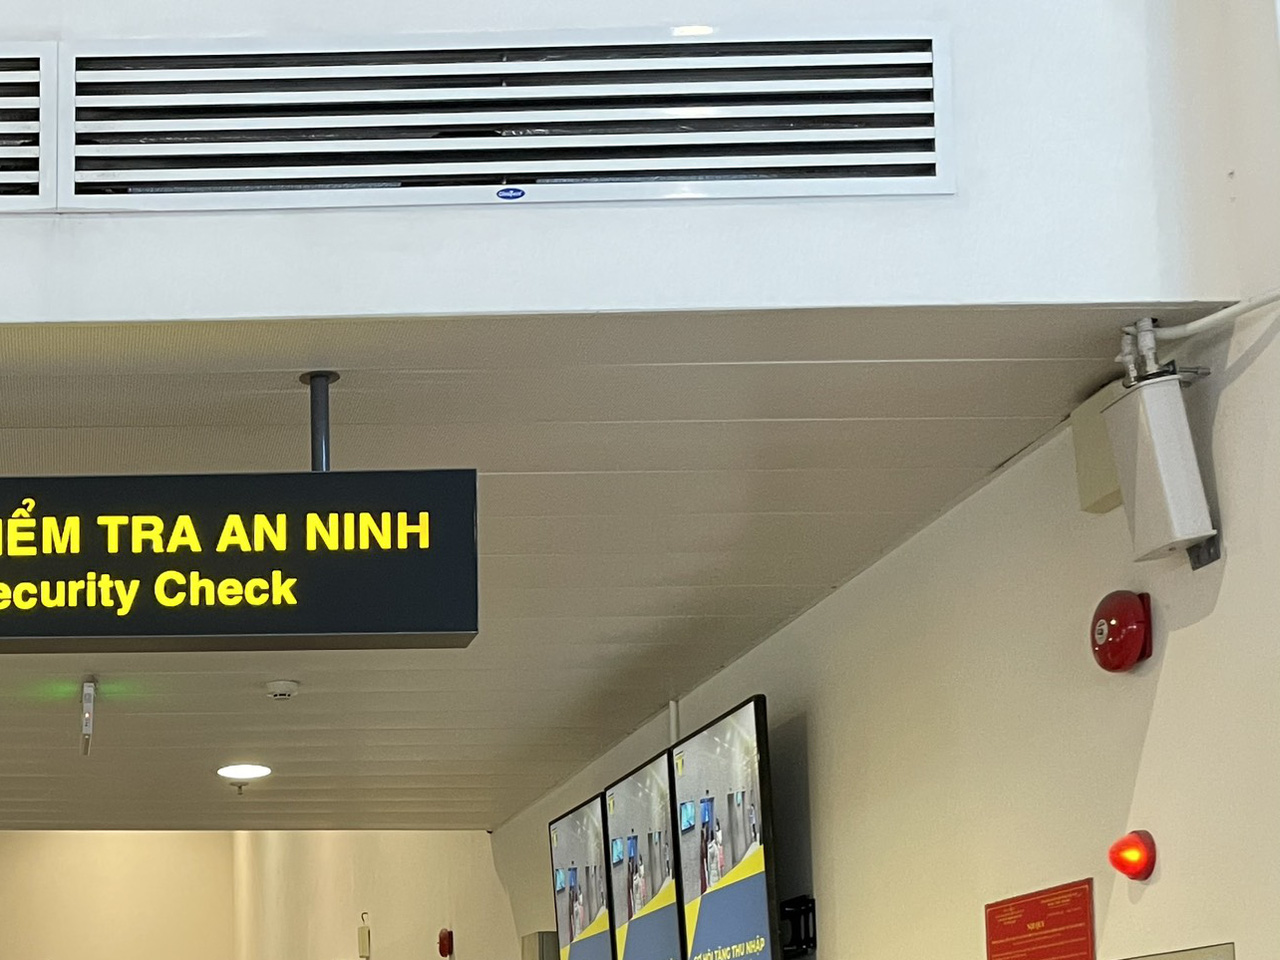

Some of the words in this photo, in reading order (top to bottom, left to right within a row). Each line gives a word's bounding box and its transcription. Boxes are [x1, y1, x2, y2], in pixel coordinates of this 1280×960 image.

[97, 514, 202, 554] TRA
[216, 513, 287, 553] AN
[306, 511, 430, 551] NINH
[154, 569, 298, 607] Check
